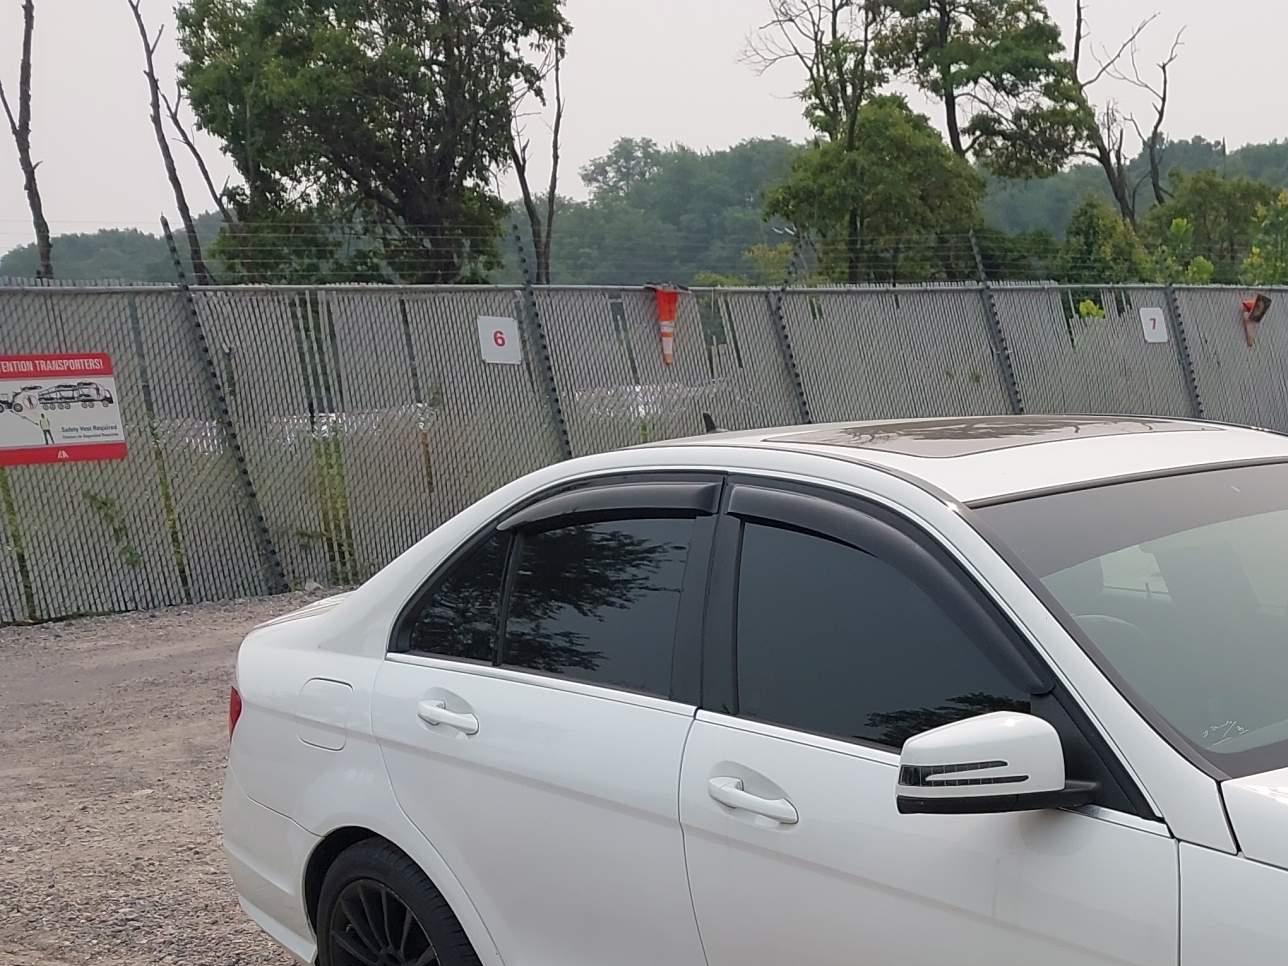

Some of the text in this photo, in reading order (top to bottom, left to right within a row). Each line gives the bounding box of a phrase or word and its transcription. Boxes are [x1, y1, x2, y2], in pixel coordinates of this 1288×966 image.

[492, 330, 506, 347] 6
[0, 358, 104, 373] ENTION TRANSPORTERS!
